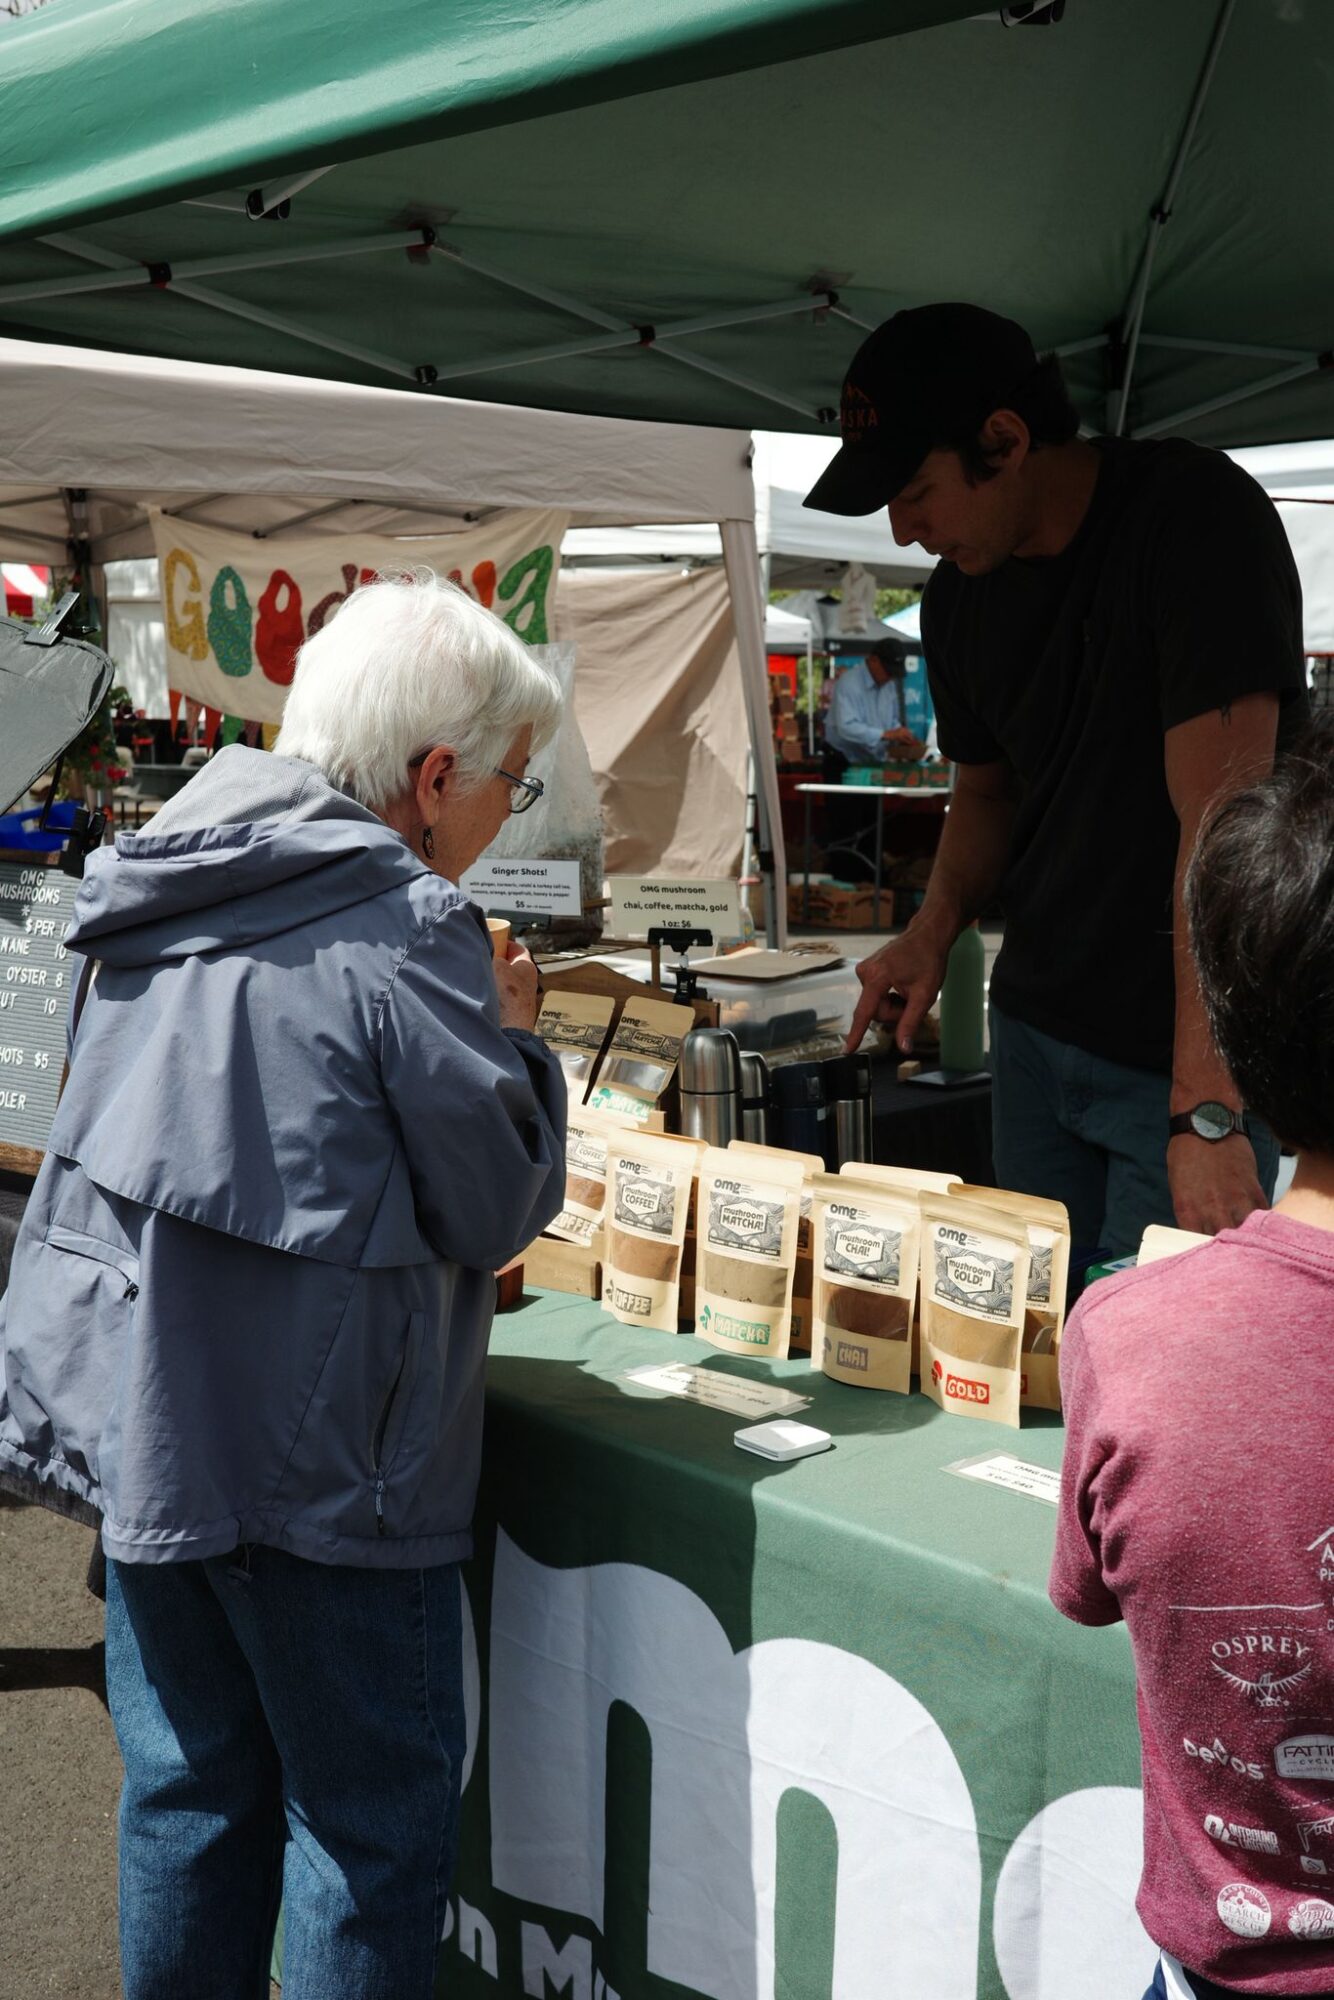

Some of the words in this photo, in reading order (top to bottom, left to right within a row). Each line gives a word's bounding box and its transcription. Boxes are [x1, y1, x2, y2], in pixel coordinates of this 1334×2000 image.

[20, 869, 45, 887] OMG
[492, 866, 519, 877] Ginger
[521, 867, 548, 876] Shots!
[640, 885, 660, 893] OMG
[661, 885, 706, 894] mushroom
[515, 900, 525, 909] $5
[623, 902, 643, 911] chai,
[644, 901, 673, 911] coffee,
[674, 903, 708, 912] matcha,
[709, 903, 728, 912] gold
[34, 919, 56, 937] PER
[681, 920, 691, 928] $6
[0, 936, 31, 955] MANE
[6, 966, 47, 986] OYSTER
[55, 972, 64, 988] 8
[44, 998, 57, 1015] 10
[541, 1009, 562, 1020] omg
[620, 1016, 641, 1027] omg
[34, 1052, 49, 1069] $5
[619, 1158, 641, 1174] omg
[625, 1186, 658, 1200] mushroom
[714, 1178, 742, 1194] omg
[625, 1195, 655, 1211] COFFEE!
[723, 1207, 764, 1221] mushroom
[830, 1203, 858, 1221] omg
[722, 1214, 764, 1232] MATCHA!
[839, 1233, 881, 1248] mushroom
[938, 1227, 968, 1246] omg
[845, 1242, 870, 1258] CHAI!
[949, 1259, 991, 1278] mushroom
[953, 1269, 983, 1287] GOLD!
[714, 1314, 769, 1344] MATCHA
[838, 1344, 867, 1370] CHAI
[946, 1378, 988, 1401] GOLD
[1212, 1634, 1311, 1660] OSPREY
